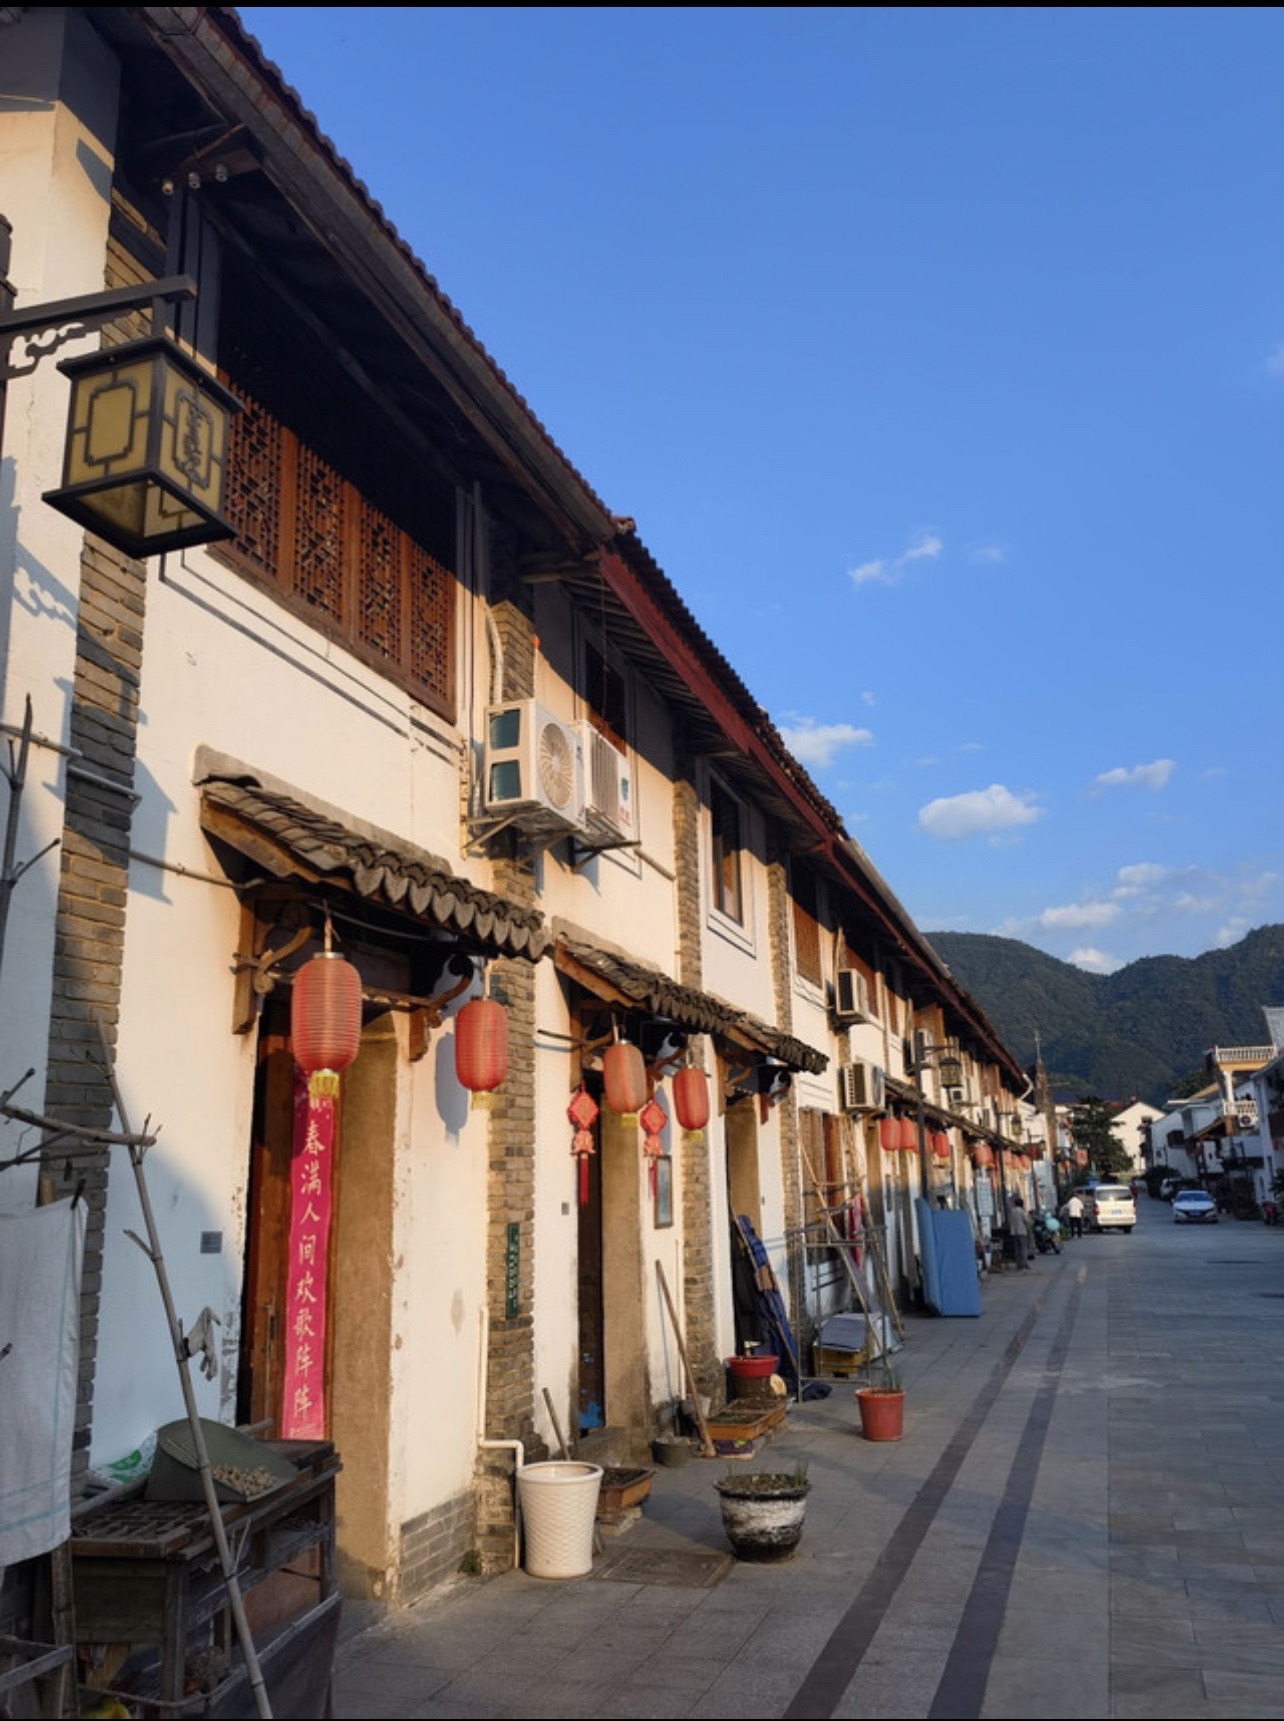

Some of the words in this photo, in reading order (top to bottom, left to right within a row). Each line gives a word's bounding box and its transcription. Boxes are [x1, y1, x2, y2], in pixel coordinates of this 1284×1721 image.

[293, 1119, 325, 1420] 春满人间欢歌阵阵
